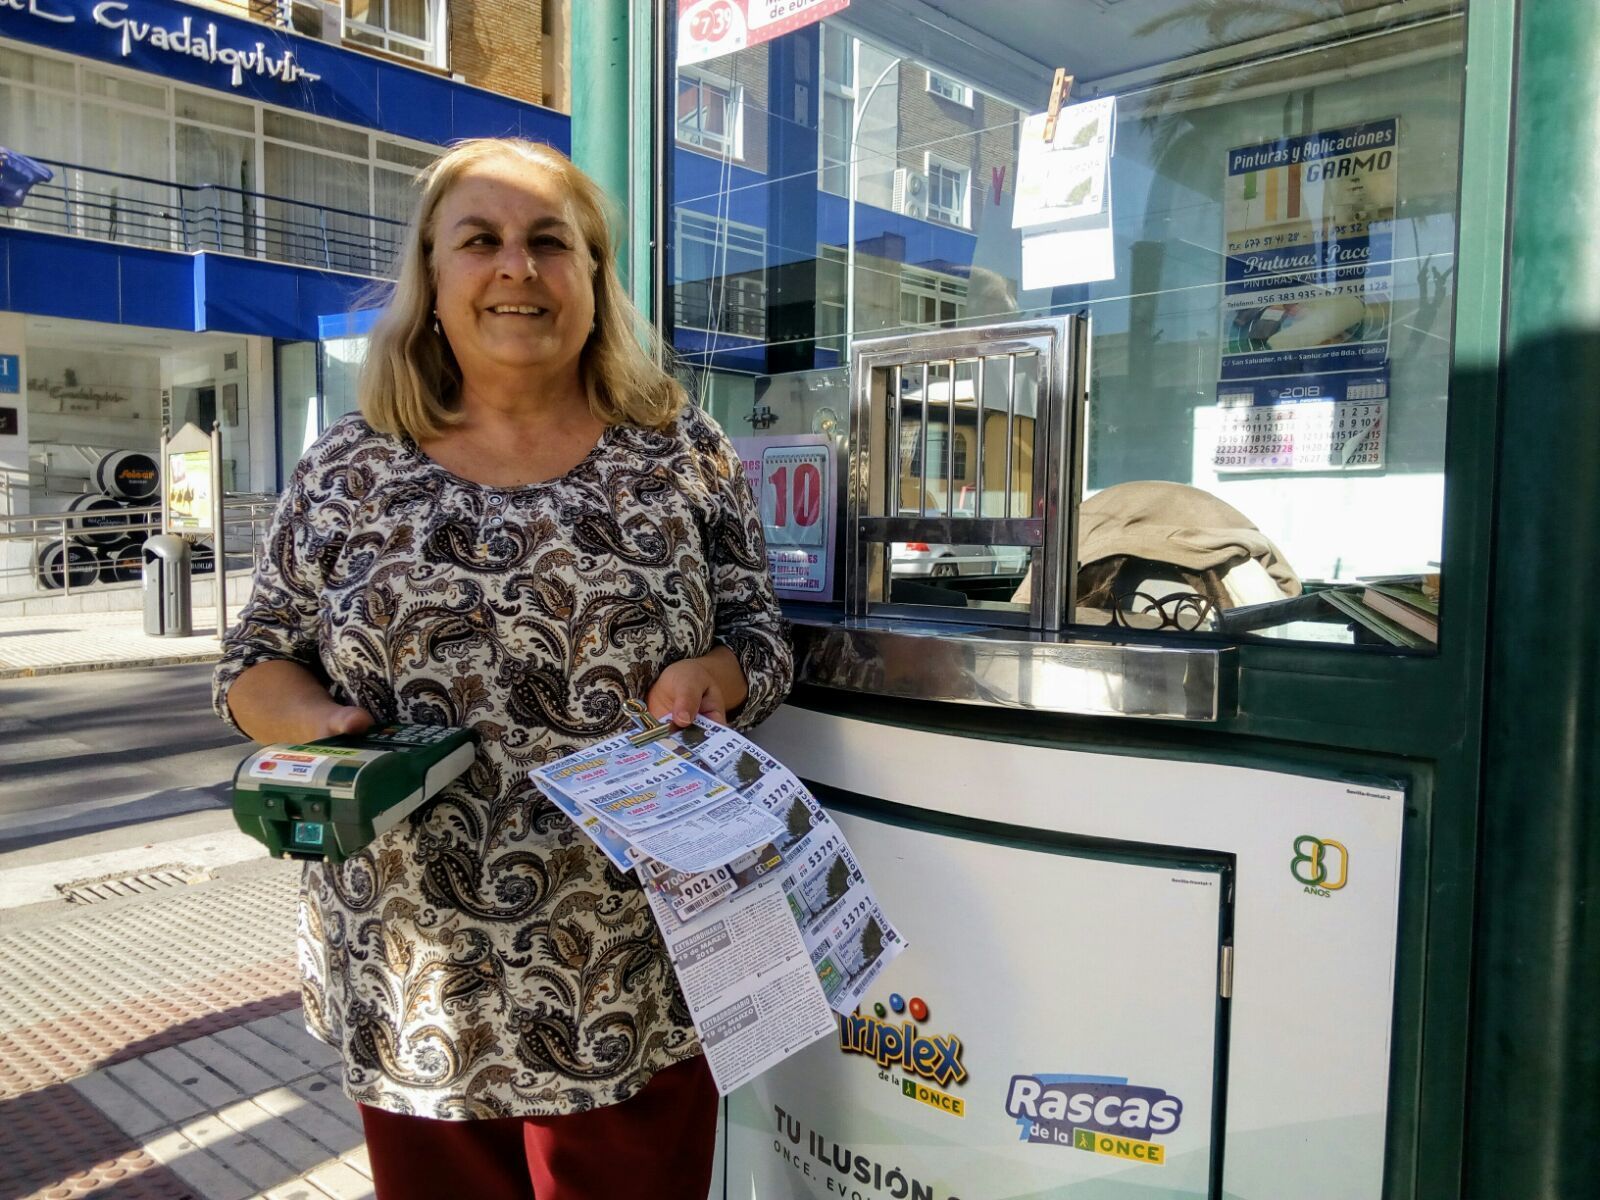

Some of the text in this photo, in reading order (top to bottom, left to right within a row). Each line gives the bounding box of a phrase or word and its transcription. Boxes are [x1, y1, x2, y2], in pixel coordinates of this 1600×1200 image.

[769, 6, 785, 19] de
[93, 2, 320, 86] Guadalquivir
[1233, 129, 1392, 170] Pinturas y Aplicaciones
[1306, 150, 1392, 183] GARMO
[1243, 244, 1373, 274] Pinturas Paco
[1243, 275, 1293, 289] PINTURAS
[1257, 295, 1275, 305] 956
[1278, 292, 1295, 302] 383
[1298, 290, 1316, 300] 935
[1346, 284, 1365, 293] 514
[1369, 281, 1388, 291] 128
[1279, 386, 1320, 398] 2018
[768, 463, 820, 527] 10
[596, 737, 630, 753] 4631
[708, 737, 742, 763] 53791
[744, 744, 767, 762] ONCE
[645, 766, 683, 785] 46317
[762, 778, 795, 809] 53791
[797, 788, 817, 812] ONCE
[807, 834, 840, 869] 53791
[839, 845, 856, 871] ONCE
[1290, 834, 1349, 890] 80
[684, 868, 727, 899] 90210
[1303, 885, 1331, 898] AÑOS
[842, 895, 872, 930] 53791
[872, 906, 889, 932] ONCE
[878, 1070, 961, 1113] de la ONCE
[1009, 1078, 1179, 1131] Rascas
[774, 1104, 933, 1200] TU ILUSIÓN
[1029, 1122, 1160, 1161] de la ONCE
